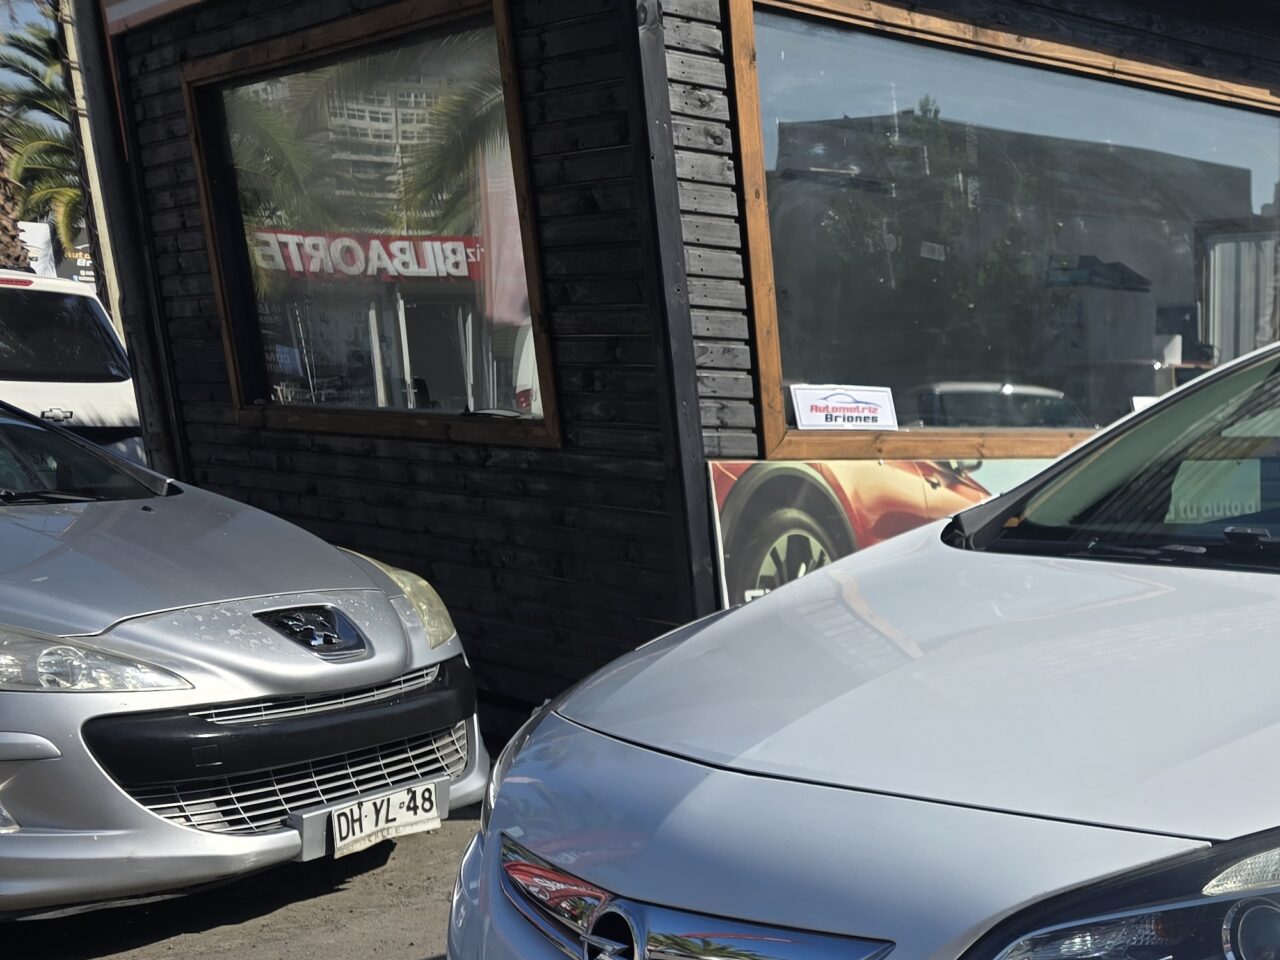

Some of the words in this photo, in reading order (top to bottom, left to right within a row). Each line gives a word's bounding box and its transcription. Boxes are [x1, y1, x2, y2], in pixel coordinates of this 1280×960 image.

[810, 404, 878, 414] Automotriz
[825, 413, 878, 423] Briones
[1179, 499, 1197, 518] tu
[1201, 499, 1241, 518] auto
